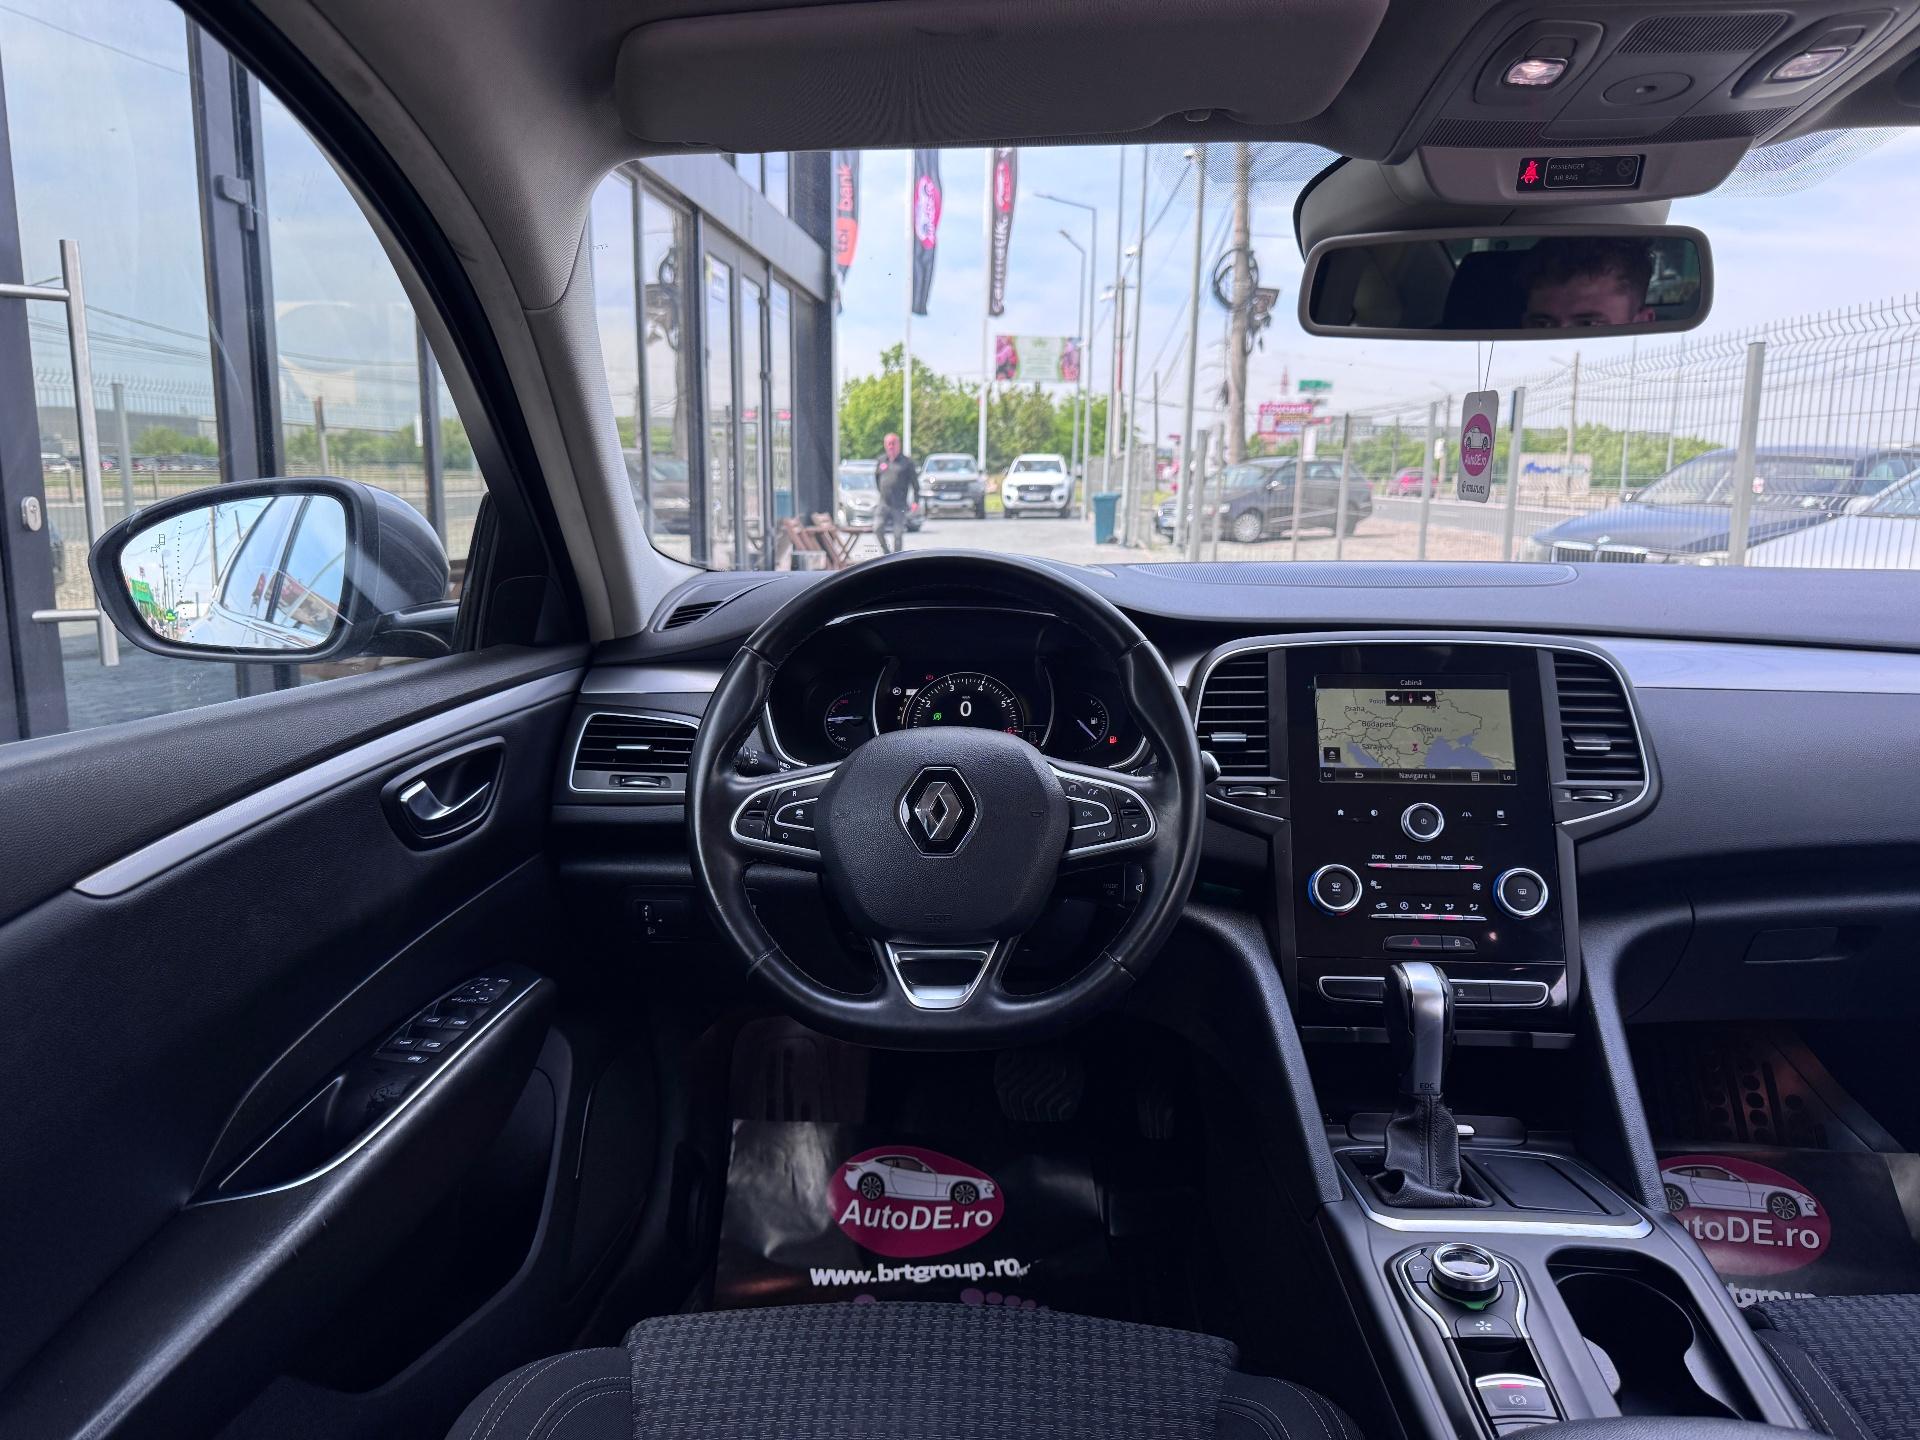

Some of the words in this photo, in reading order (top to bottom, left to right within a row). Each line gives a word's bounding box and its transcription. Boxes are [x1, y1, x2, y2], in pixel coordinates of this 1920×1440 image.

[837, 164, 854, 211] bank
[949, 684, 955, 692] 3
[977, 684, 984, 692] 4
[925, 700, 931, 708] 2
[960, 700, 972, 717] 0
[1001, 700, 1007, 708] 5
[1361, 720, 1395, 730] Budapest
[1361, 743, 1392, 751] Sarajevo
[1323, 771, 1332, 779] Lo
[1399, 771, 1427, 780] Navigare
[838, 1198, 994, 1231] AutoDE.ro
[1683, 1215, 1820, 1249] toDE.ro
[809, 1257, 1021, 1287] www.brtgroup.ro
